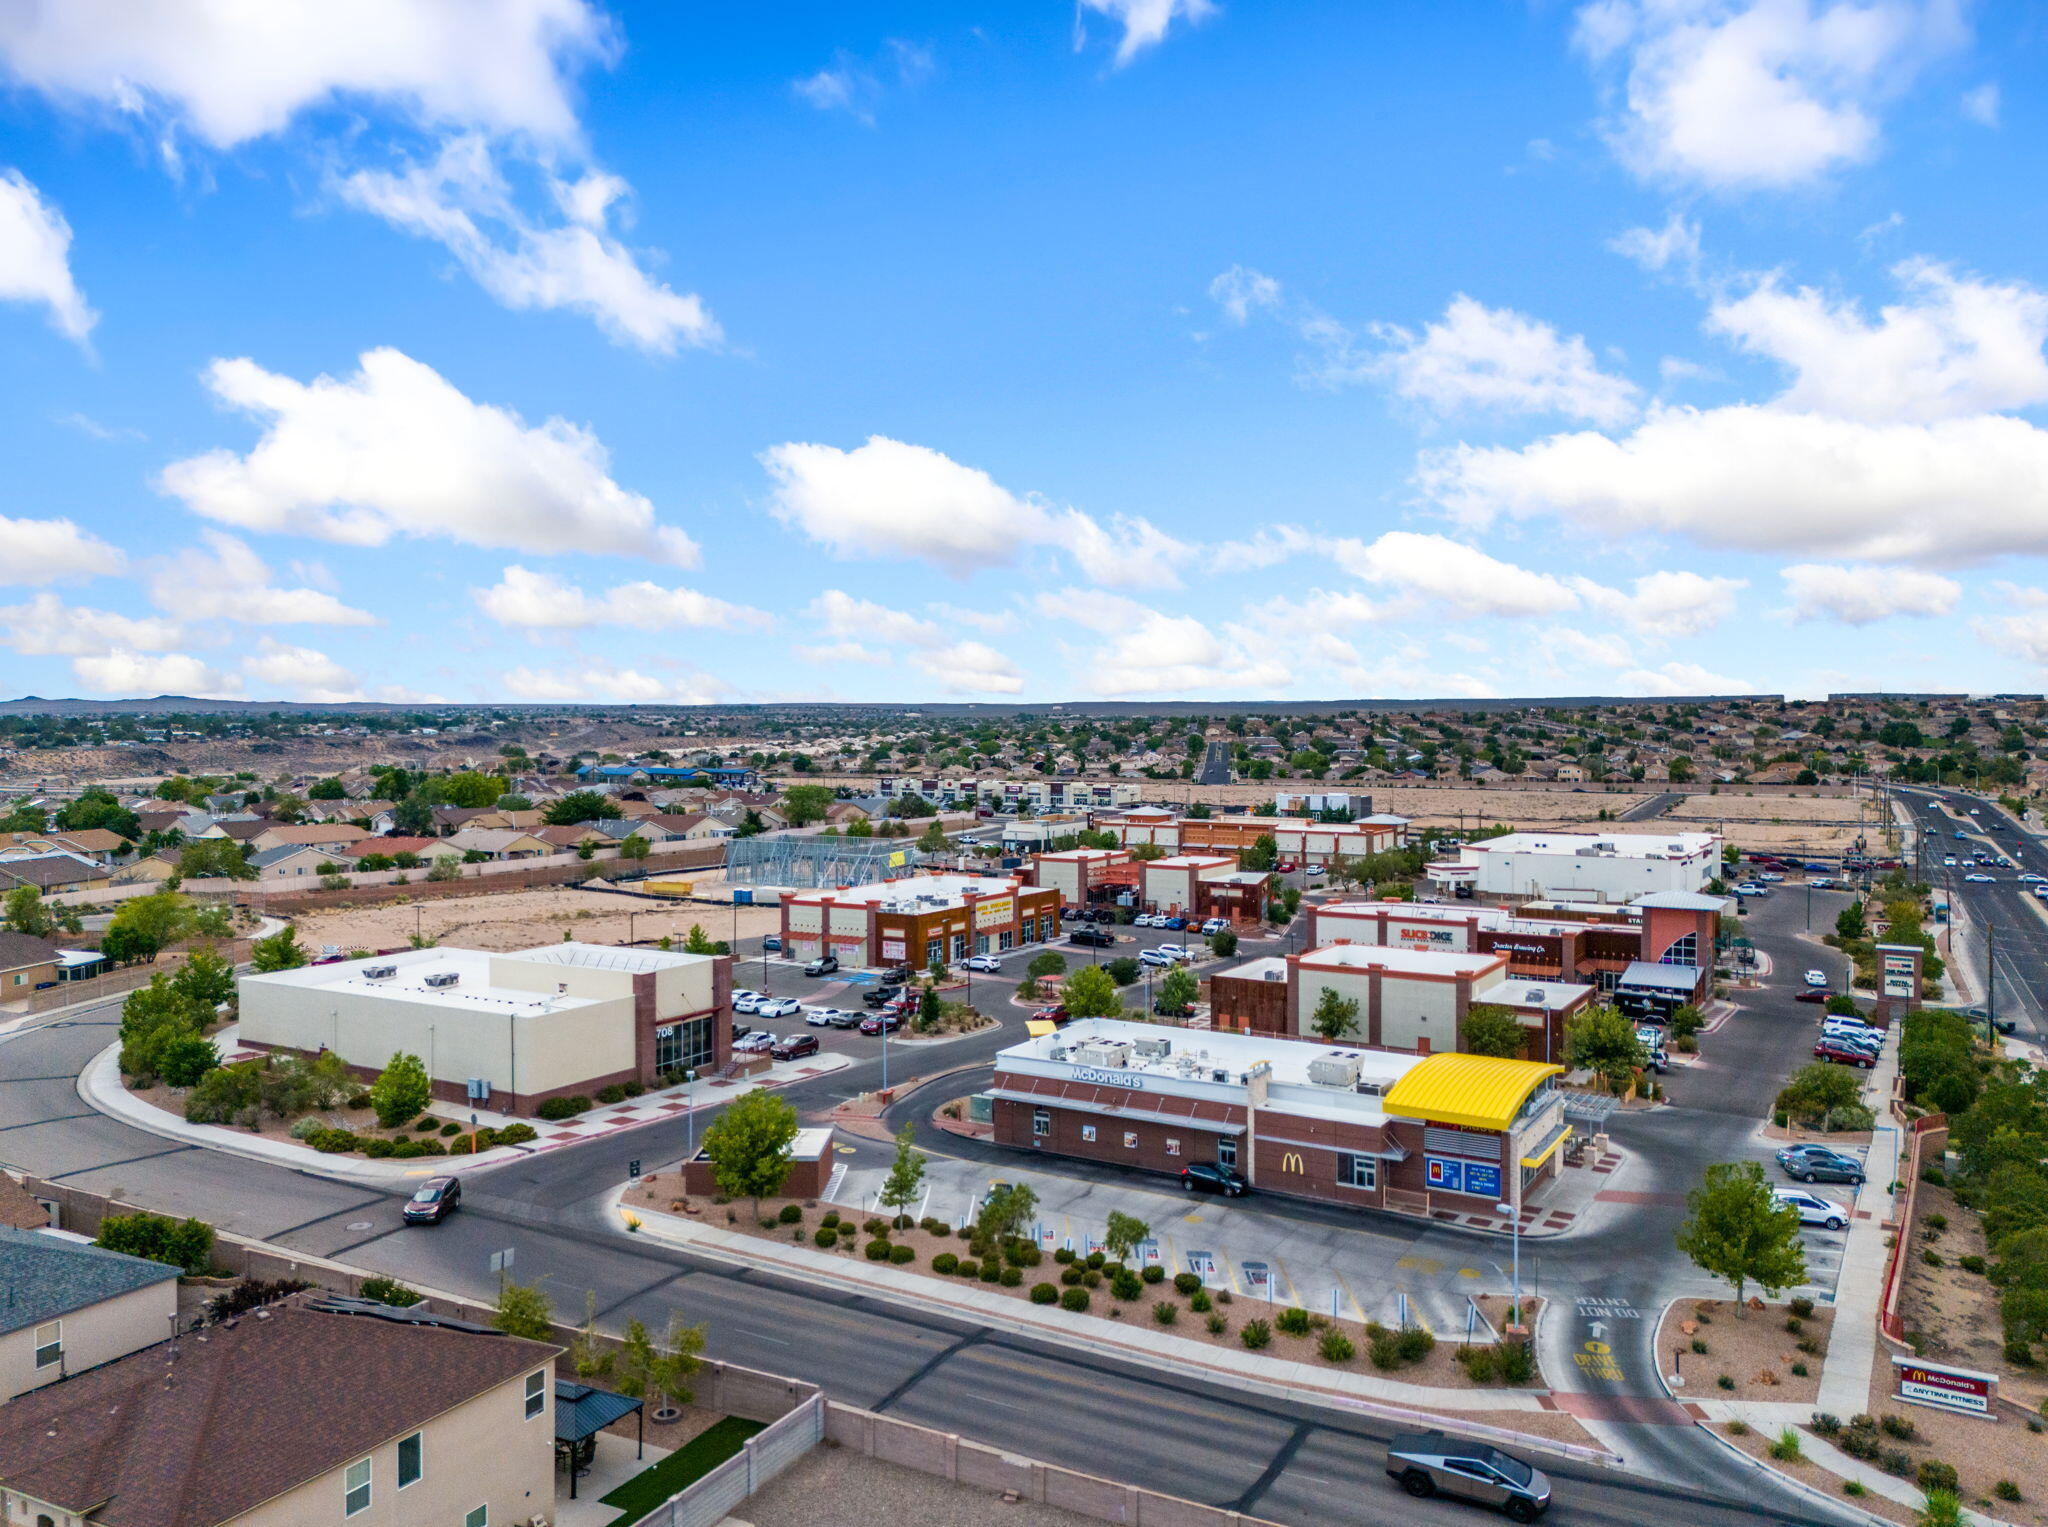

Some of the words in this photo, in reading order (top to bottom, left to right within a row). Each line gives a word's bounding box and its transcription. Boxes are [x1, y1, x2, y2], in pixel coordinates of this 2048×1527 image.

[1492, 941, 1512, 950] Tractor
[1513, 943, 1535, 953] Brewing
[656, 1026, 673, 1039] 708
[1072, 1066, 1142, 1088] McDonald's
[1574, 1296, 1630, 1307] ENTER
[1580, 1306, 1612, 1318] NOT
[1615, 1308, 1640, 1318] DO
[1573, 1353, 1616, 1367] DRIVE
[1580, 1367, 1625, 1381] THRU
[1927, 1374, 1976, 1390] McDonald's
[1913, 1387, 1949, 1400] ANYTIME
[1950, 1394, 1984, 1407] FITNESS
